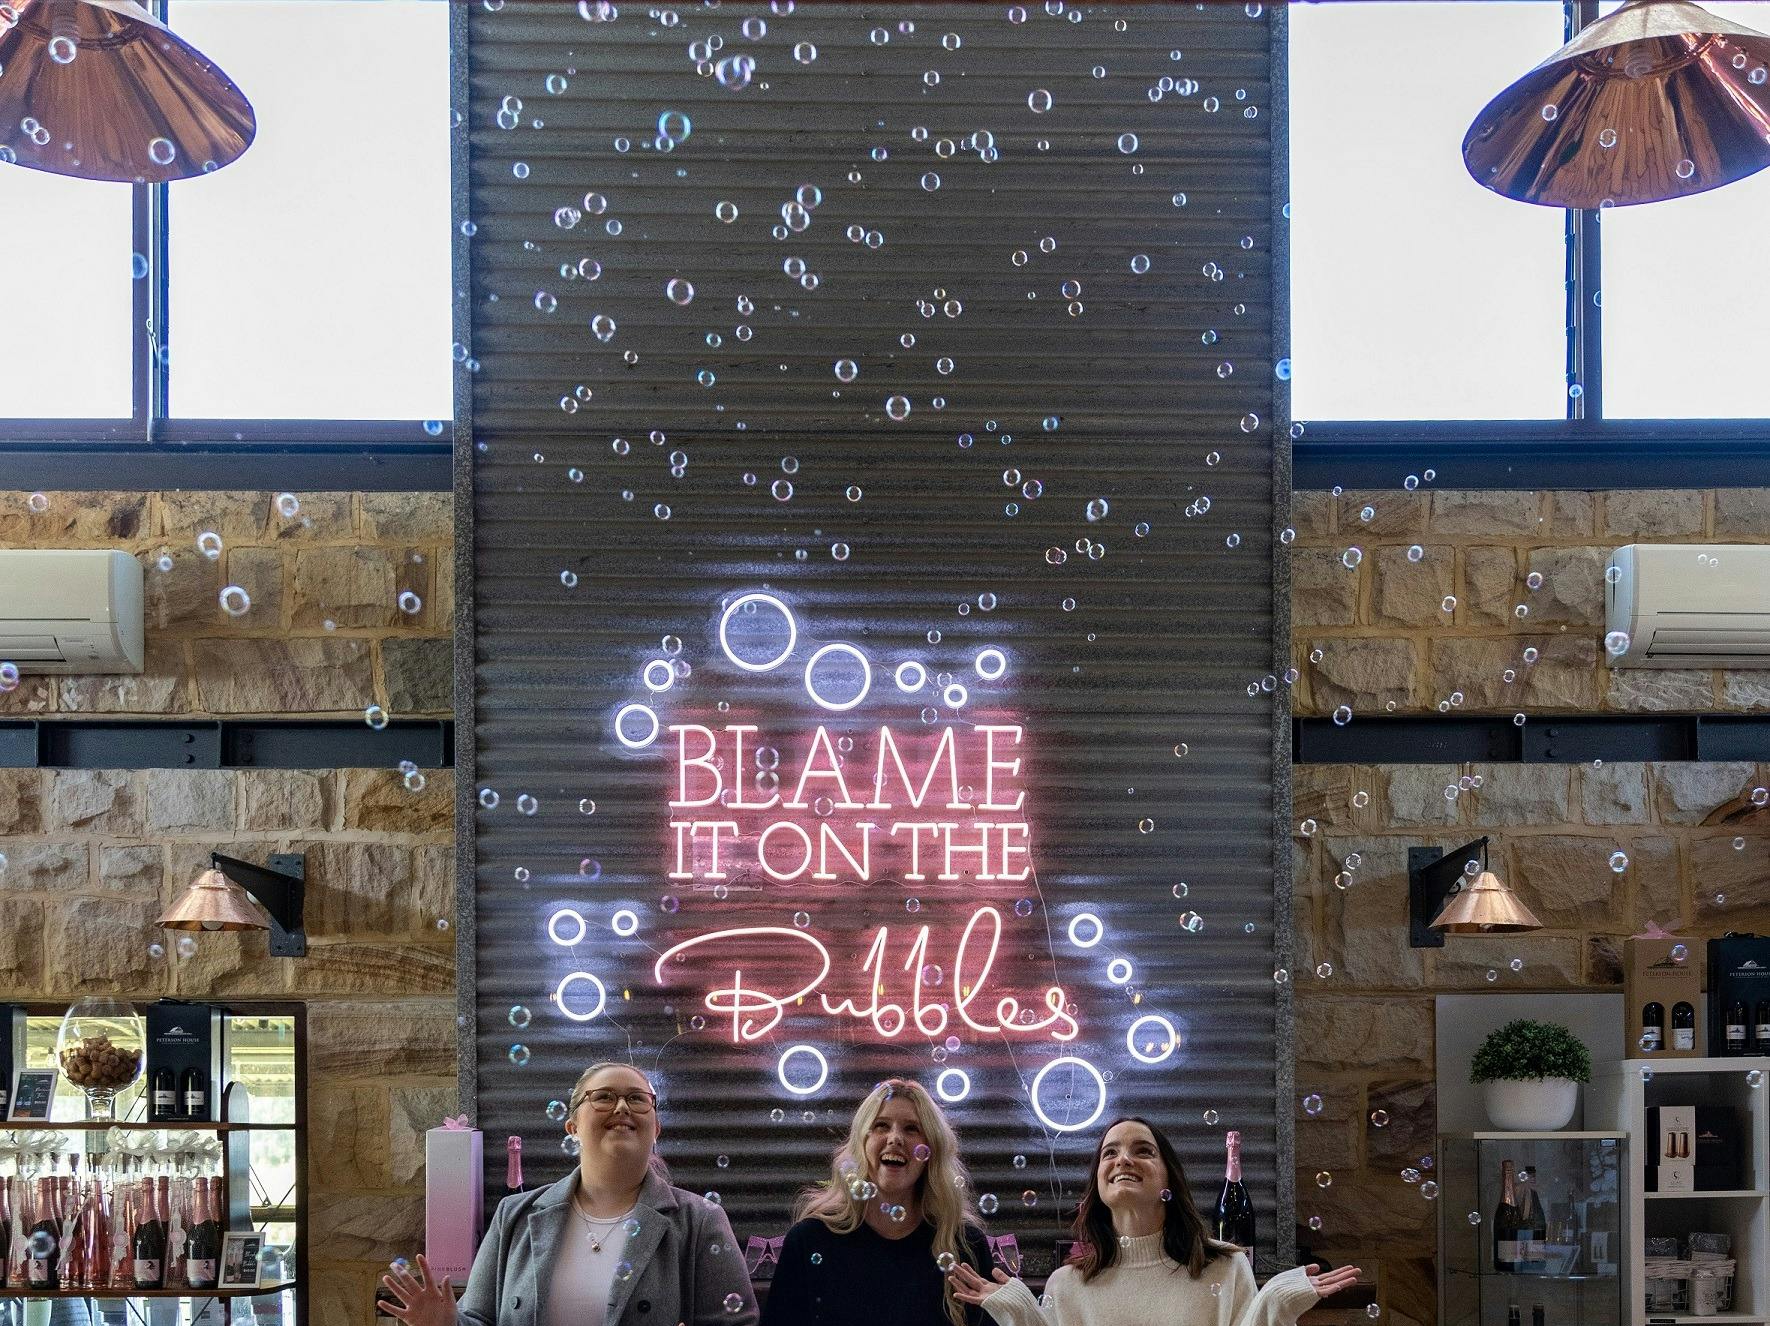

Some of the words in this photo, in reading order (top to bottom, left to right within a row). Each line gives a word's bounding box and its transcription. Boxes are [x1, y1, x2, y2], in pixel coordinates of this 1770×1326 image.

[668, 724, 1025, 811] BLAME
[668, 822, 739, 879] IT
[757, 821, 876, 880] ON
[890, 822, 1030, 880] THE
[654, 906, 1079, 1043] Bubbles
